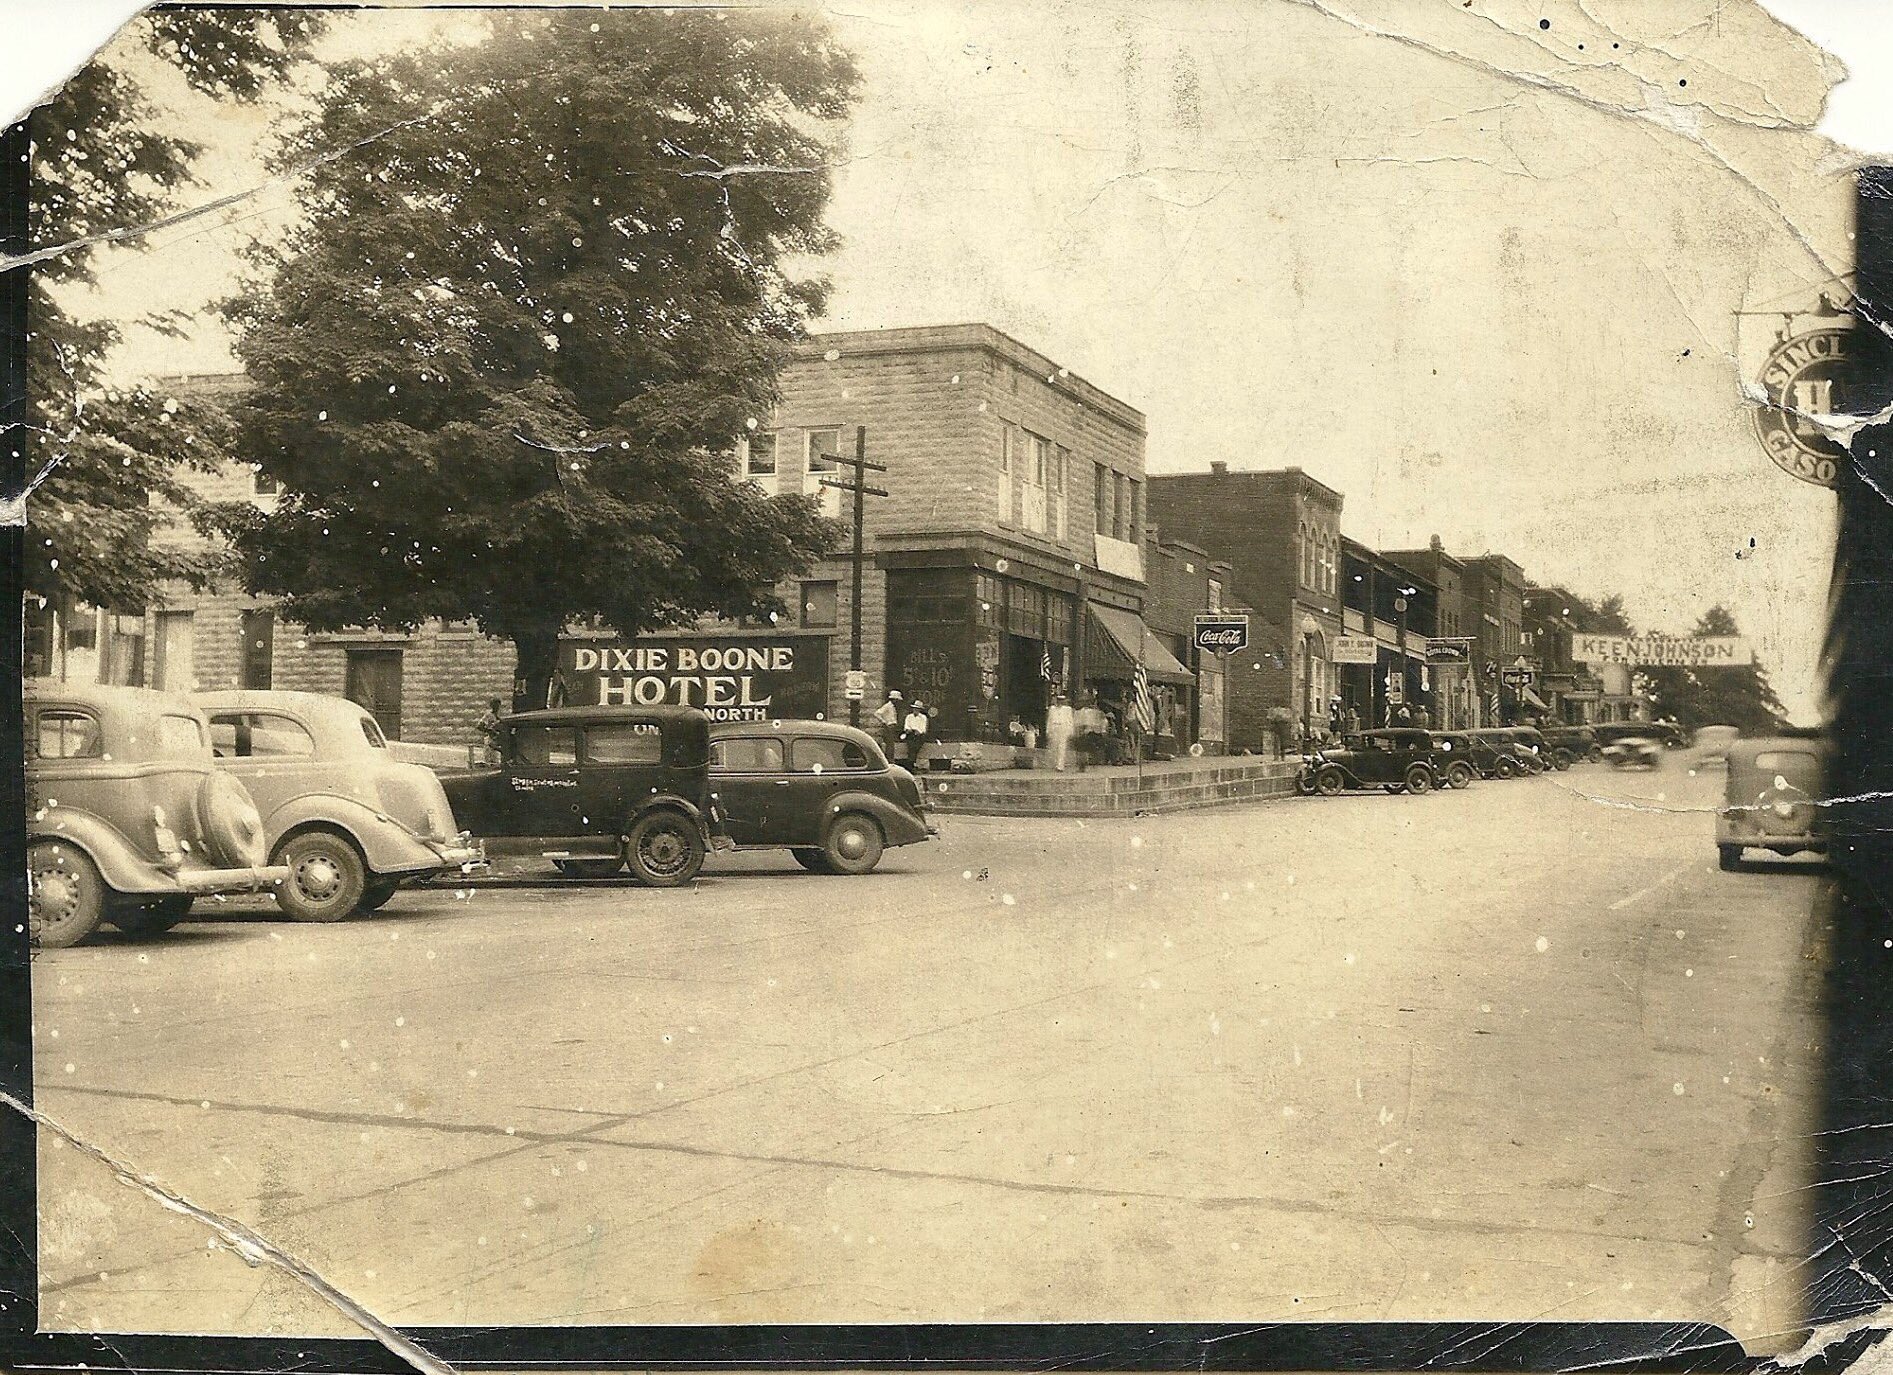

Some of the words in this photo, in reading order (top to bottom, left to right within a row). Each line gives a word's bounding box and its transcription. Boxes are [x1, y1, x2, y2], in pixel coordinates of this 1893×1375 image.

[1199, 629, 1242, 645] Coca-Cola
[1582, 639, 1641, 657] KEEN
[1643, 642, 1734, 658] JOHNSON
[575, 648, 668, 671] DIXIE
[677, 647, 794, 671] BOONE
[597, 676, 772, 706] HOTEL
[704, 708, 766, 721] NORTH
